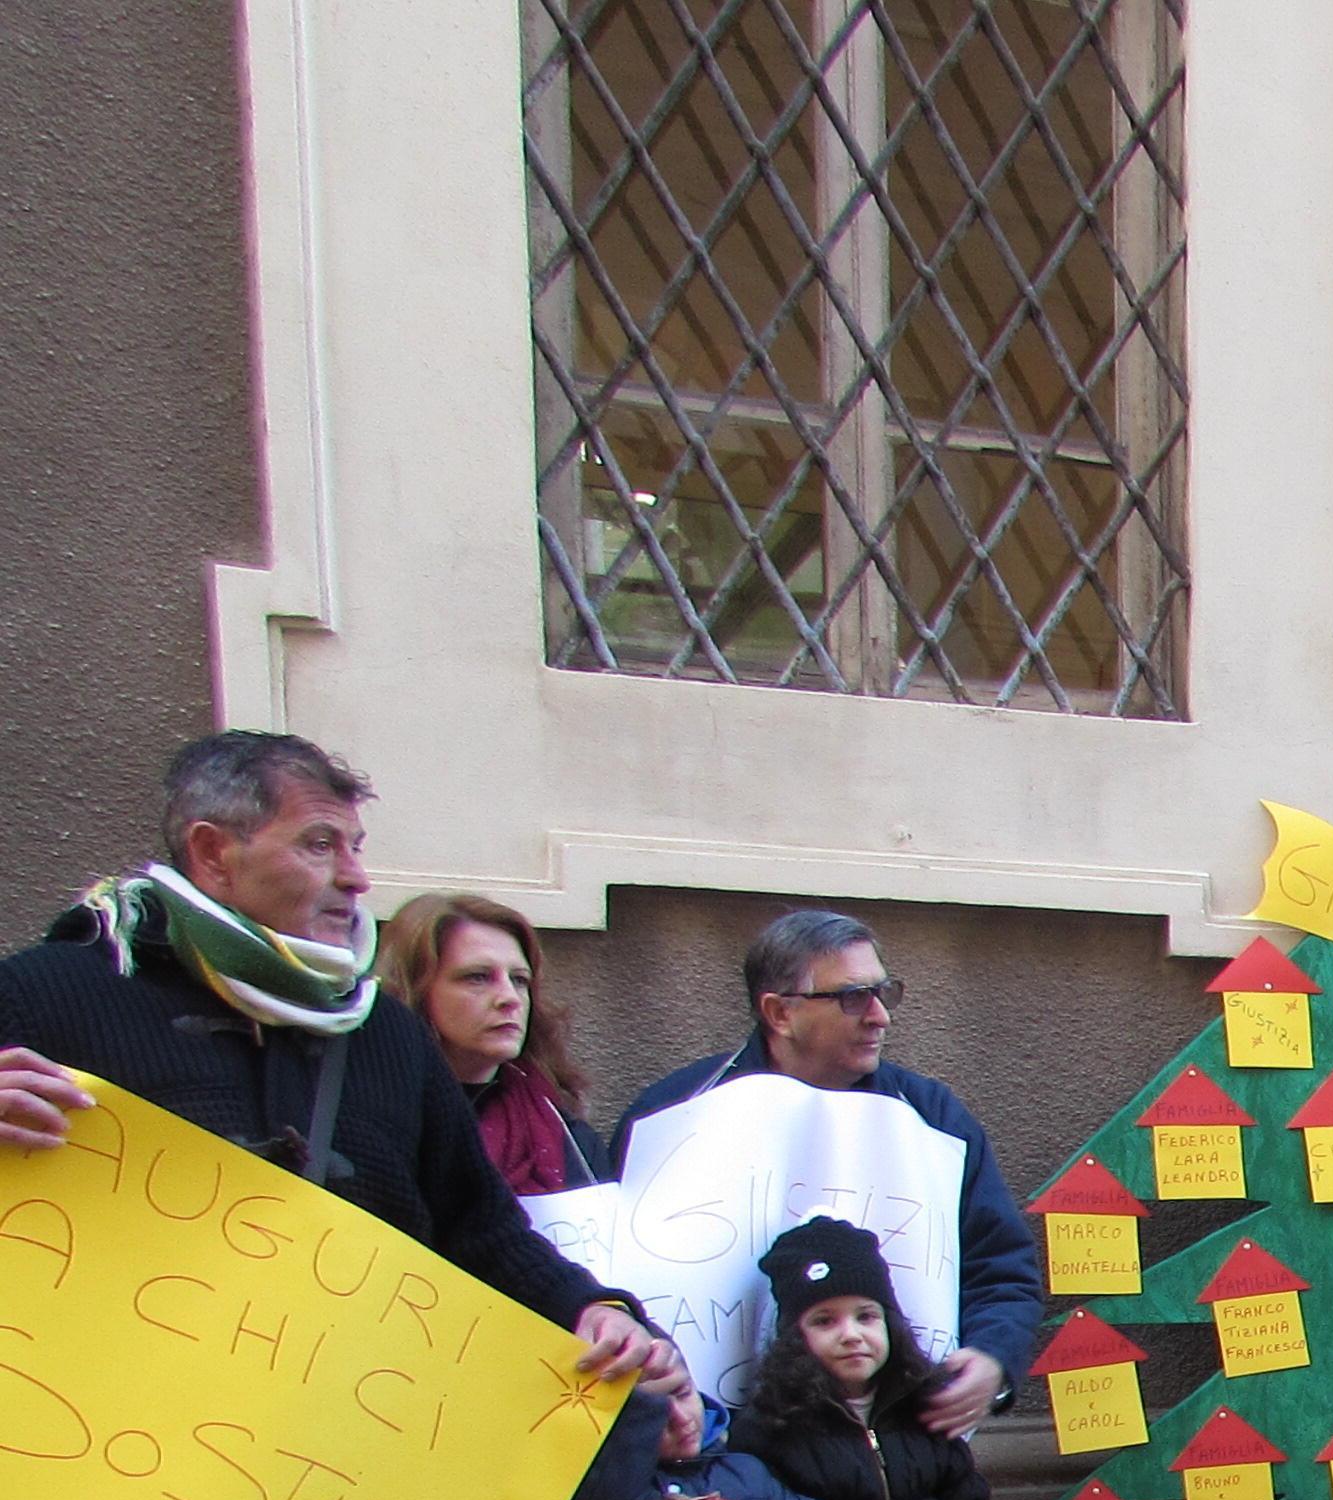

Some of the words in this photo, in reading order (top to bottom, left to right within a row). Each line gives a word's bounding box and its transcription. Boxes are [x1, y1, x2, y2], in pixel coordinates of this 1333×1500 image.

[1227, 993, 1300, 1055] GIUSTIZIA
[1155, 1102, 1238, 1118] FAMIGLIA
[1159, 1134, 1237, 1147] FEDERICO
[1174, 1153, 1219, 1164] LARA
[1163, 1171, 1240, 1184] LEANDRO
[1056, 1224, 1122, 1240] MARCO
[1051, 1261, 1141, 1275] DONATELLA
[1215, 1274, 1291, 1296] FAMIGLIA
[1223, 1303, 1285, 1319] FRANCO
[1224, 1321, 1290, 1337] TIZIANA
[1226, 1339, 1305, 1359] FRANCESCO
[1065, 1377, 1113, 1395] ALDO
[1067, 1414, 1125, 1431] CAROL
[1194, 1475, 1241, 1490] BRUNO
